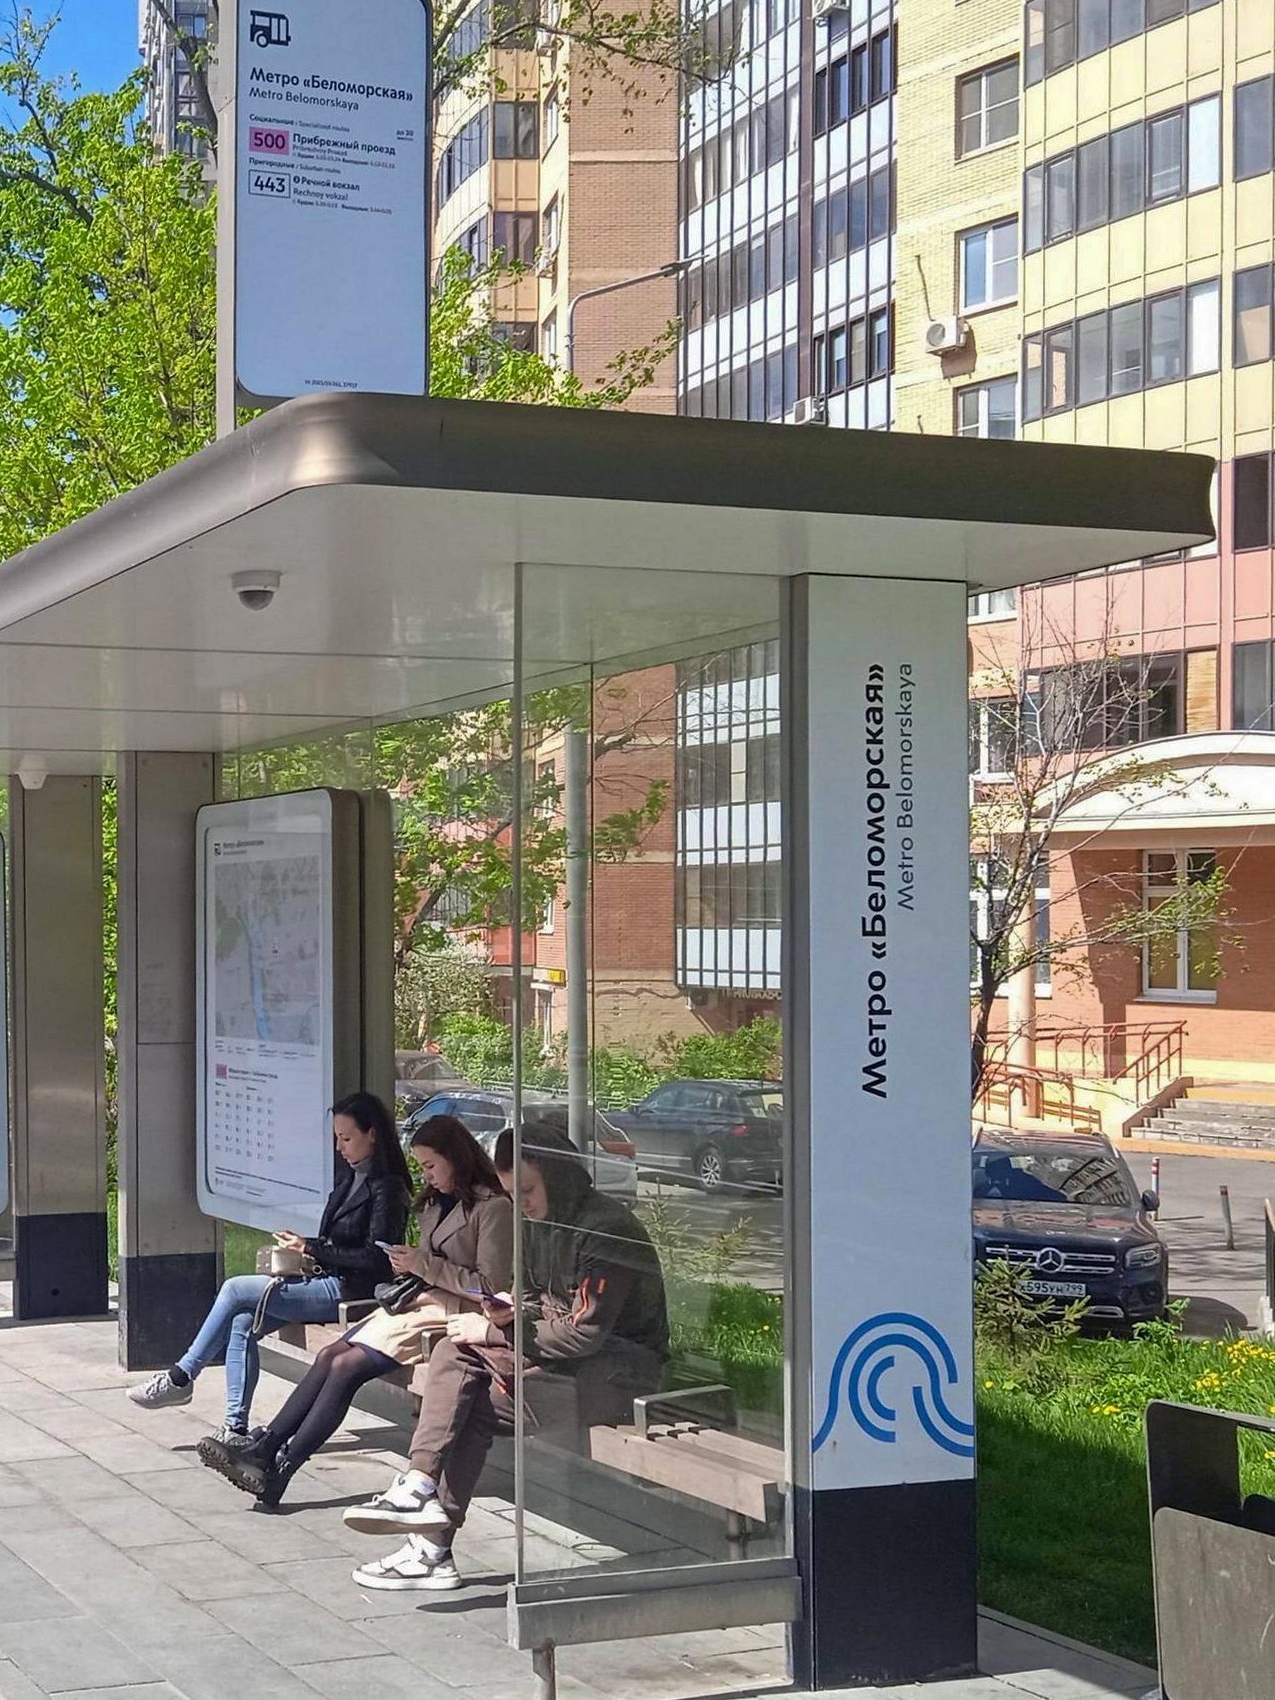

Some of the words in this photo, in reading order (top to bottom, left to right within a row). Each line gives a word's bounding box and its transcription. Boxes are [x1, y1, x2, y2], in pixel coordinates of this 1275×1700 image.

[249, 67, 299, 87] Метро
[303, 75, 413, 101] «Беломорская»
[249, 87, 283, 100] Metro
[285, 91, 359, 111] Belomorskaya
[254, 132, 285, 149] 500
[293, 133, 359, 150] Прибрежный
[361, 144, 396, 155] проезд
[254, 175, 285, 193] 443
[301, 176, 331, 187] Речной
[332, 183, 360, 191] вокзал
[293, 188, 324, 200] Rechnoy
[325, 192, 348, 200] vokzal
[895, 663, 915, 829] Belomorskaya
[862, 663, 890, 959] «Беломорская»
[897, 837, 914, 910] Metro
[862, 970, 892, 1098] Метро
